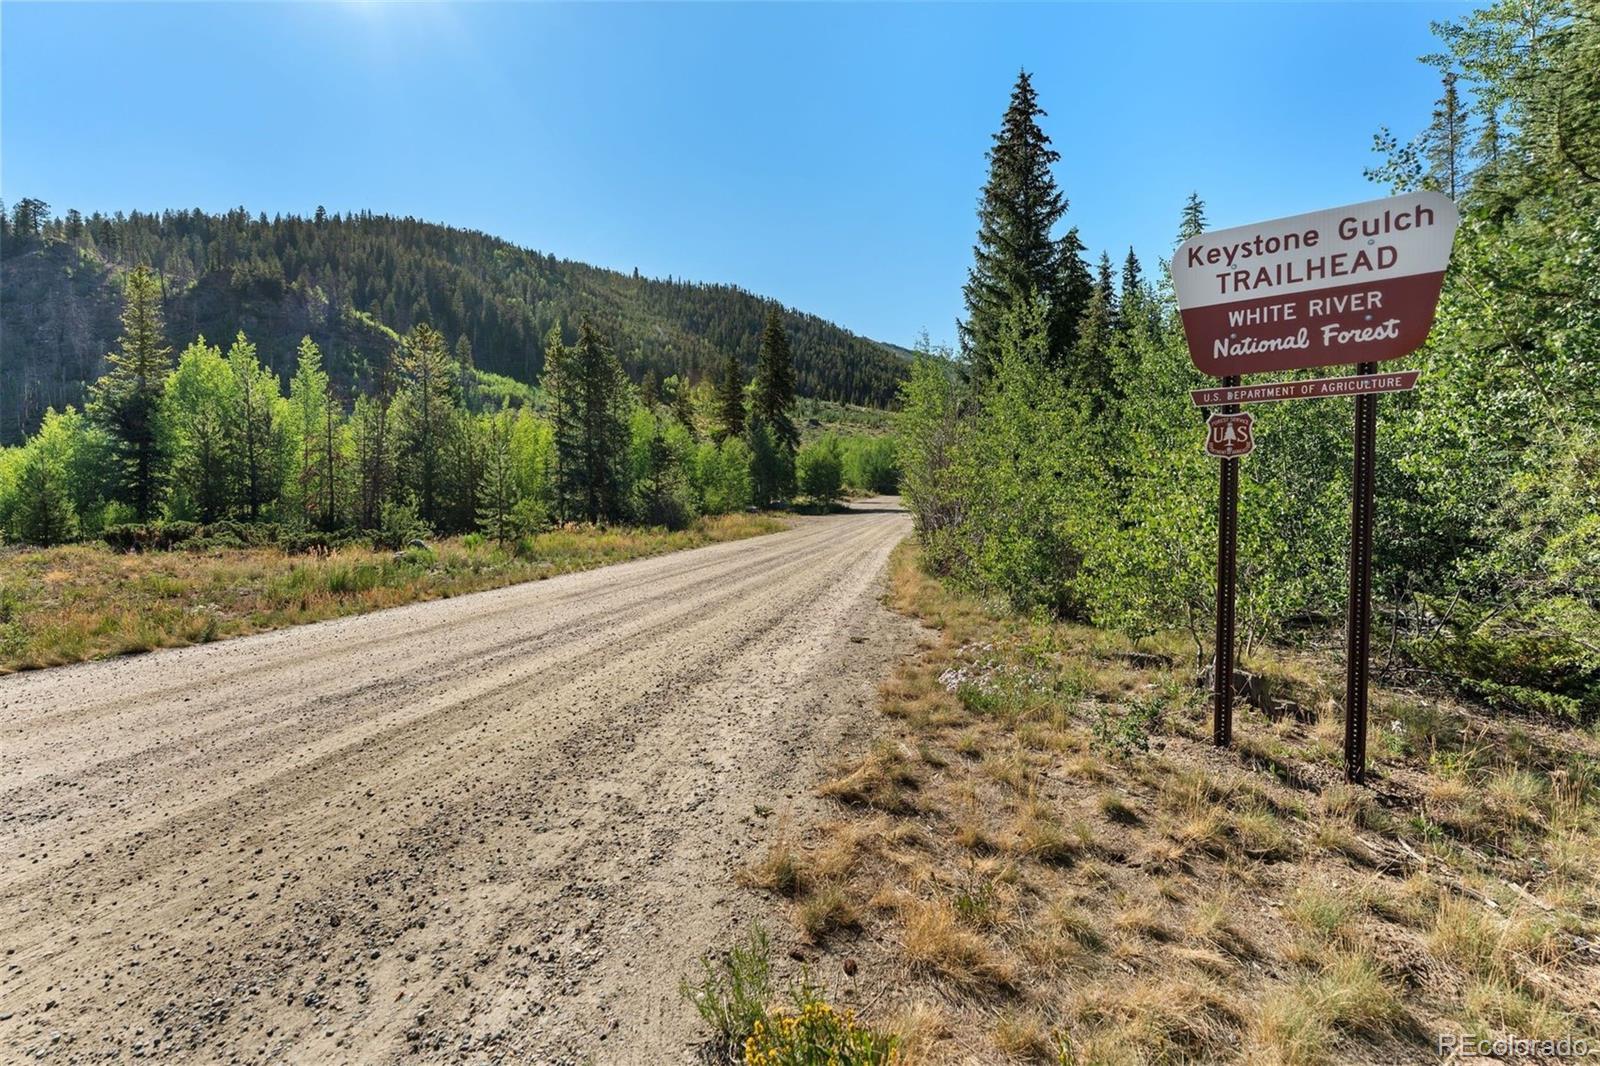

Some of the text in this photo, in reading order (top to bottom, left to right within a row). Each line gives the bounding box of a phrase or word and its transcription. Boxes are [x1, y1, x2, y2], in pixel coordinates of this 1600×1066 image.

[1188, 204, 1434, 268] Keystone Gulch
[1216, 245, 1398, 294] TRAILHEAD
[1228, 291, 1383, 328] WHITE RIVER
[1213, 318, 1401, 359] National Forest
[1203, 376, 1403, 403] U.S. DEPARTMENT OF AGRICULTURE
